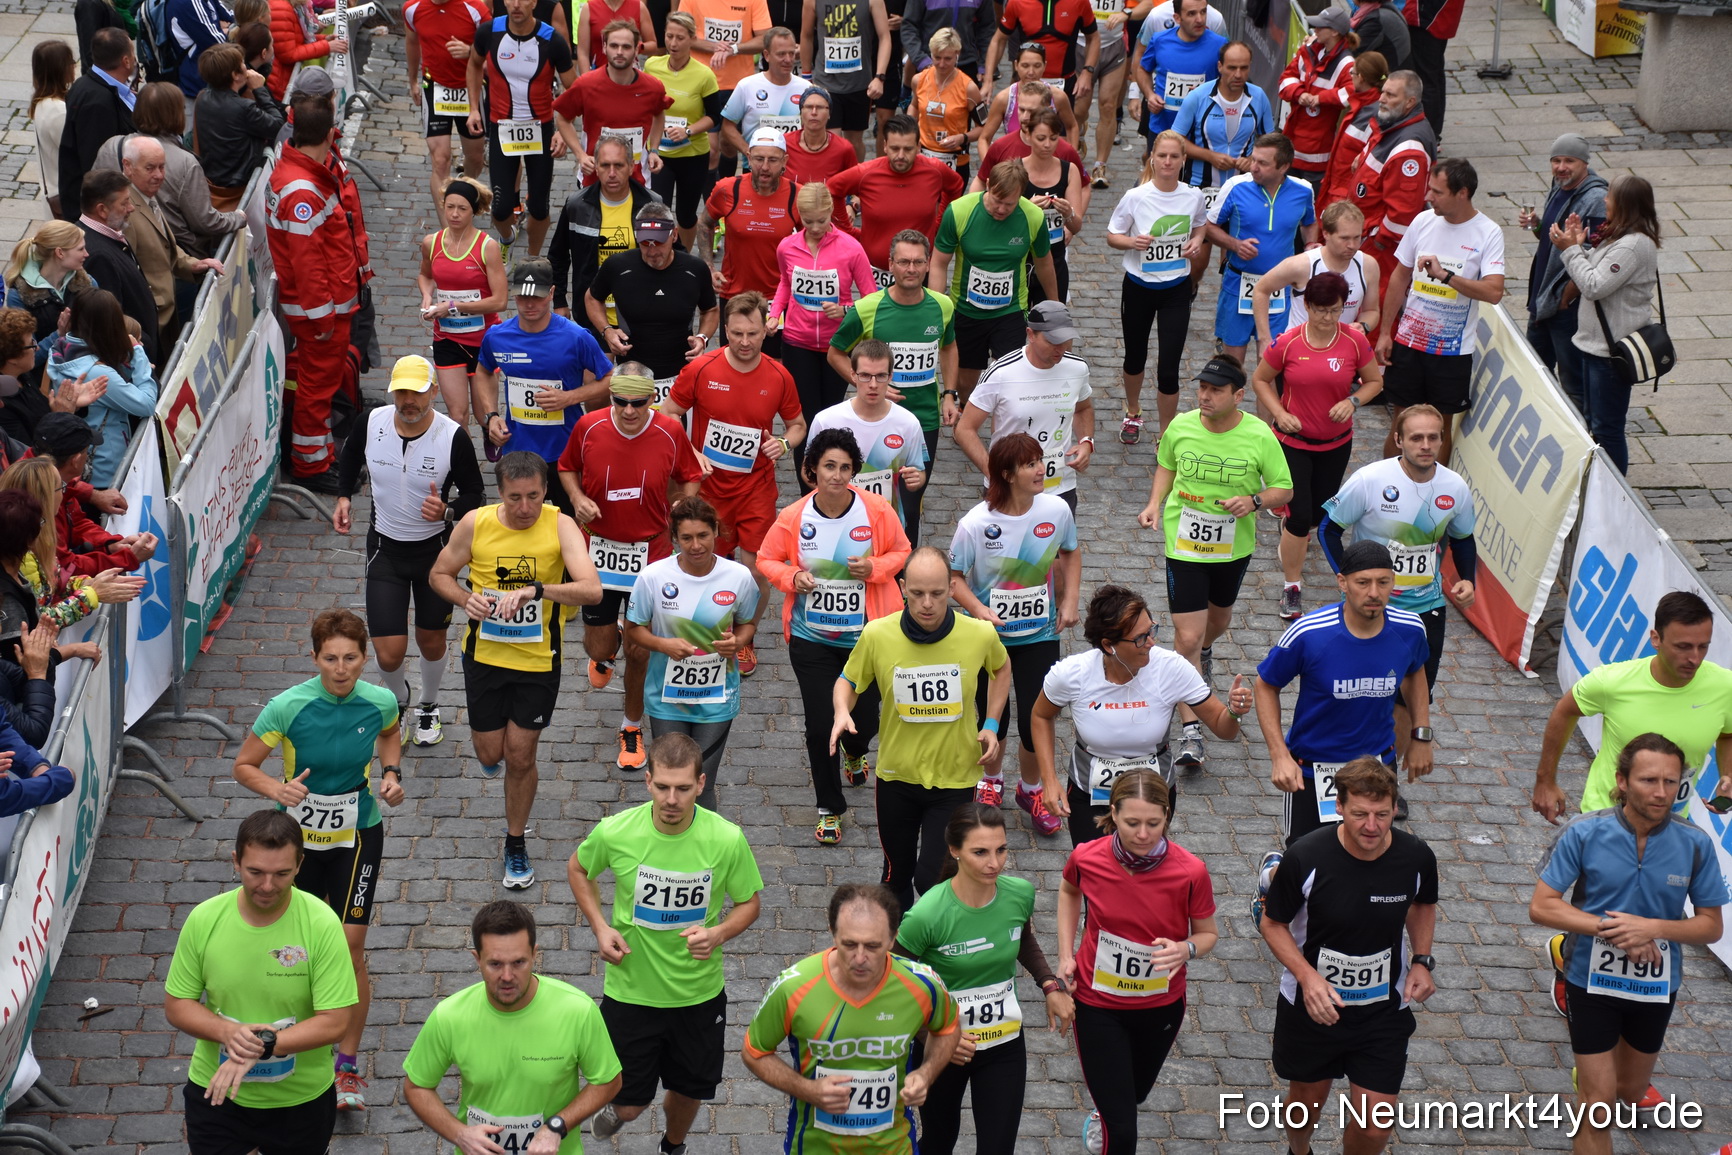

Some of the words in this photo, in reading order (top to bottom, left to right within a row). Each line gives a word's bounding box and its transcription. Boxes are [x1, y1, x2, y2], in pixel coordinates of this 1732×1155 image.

[708, 27, 738, 43] 2529
[829, 46, 858, 60] 2176
[442, 88, 467, 102] 302
[508, 129, 534, 142] 103
[1146, 245, 1182, 261] 3021
[796, 278, 835, 295] 2215
[973, 278, 1010, 295] 2368
[1422, 285, 1446, 296] Matthias
[976, 297, 1001, 305] Gerhard
[893, 353, 934, 370] 2315
[901, 374, 926, 382] Thomas
[509, 381, 526, 389] PARTL
[524, 411, 547, 419] Harald
[710, 423, 727, 433] PARTL
[728, 429, 753, 438] Neumarkt
[710, 431, 755, 457] 3022
[859, 475, 883, 484] Neumarkt
[1179, 491, 1205, 503] MERZ
[1437, 498, 1454, 507] Hervis
[1183, 511, 1199, 521] PARTL
[853, 530, 872, 538] Hervis
[1037, 527, 1054, 536] Hervis
[1190, 522, 1223, 543] 351
[592, 541, 610, 549] PARTL
[1194, 544, 1214, 553] Klaus
[594, 550, 641, 572] 3055
[1394, 555, 1426, 574] 518
[716, 595, 734, 603] Hervis
[812, 591, 860, 612] 2059
[1013, 591, 1039, 600] Neumarkt
[997, 599, 1044, 620] 2456
[820, 615, 849, 625] Claudia
[500, 628, 522, 636] Franz
[1002, 622, 1037, 632] Sieglinde
[672, 665, 721, 685] 2637
[917, 671, 948, 679] Neumarkt
[907, 680, 948, 702] 168
[1333, 677, 1396, 693] HUBER
[677, 689, 711, 698] Manuela
[1347, 690, 1393, 698] TECHNOLOGY
[1104, 701, 1149, 709] KLEBL
[909, 707, 948, 716] Christian
[1098, 759, 1117, 768] PARTL
[313, 799, 346, 808] Neumarkt
[300, 806, 344, 830] 275
[307, 833, 332, 843] Klara
[639, 871, 663, 882] PARTL
[665, 876, 700, 884] Neumarkt
[354, 864, 372, 907] SKINS
[642, 883, 704, 907] 2156
[661, 913, 680, 922] Udo
[1100, 936, 1123, 950] PARTL
[1112, 952, 1155, 978] 167
[1320, 953, 1346, 965] PARTL
[1347, 958, 1382, 968] Neumarkt
[1325, 965, 1384, 987] 2591
[1117, 980, 1145, 991] Anika
[1596, 977, 1662, 996] Hans-Jürgen
[974, 990, 1006, 1002] Neumarkt
[1341, 991, 1367, 999] Claus
[964, 999, 1005, 1026] 187
[832, 1116, 878, 1128] Nikolaus
